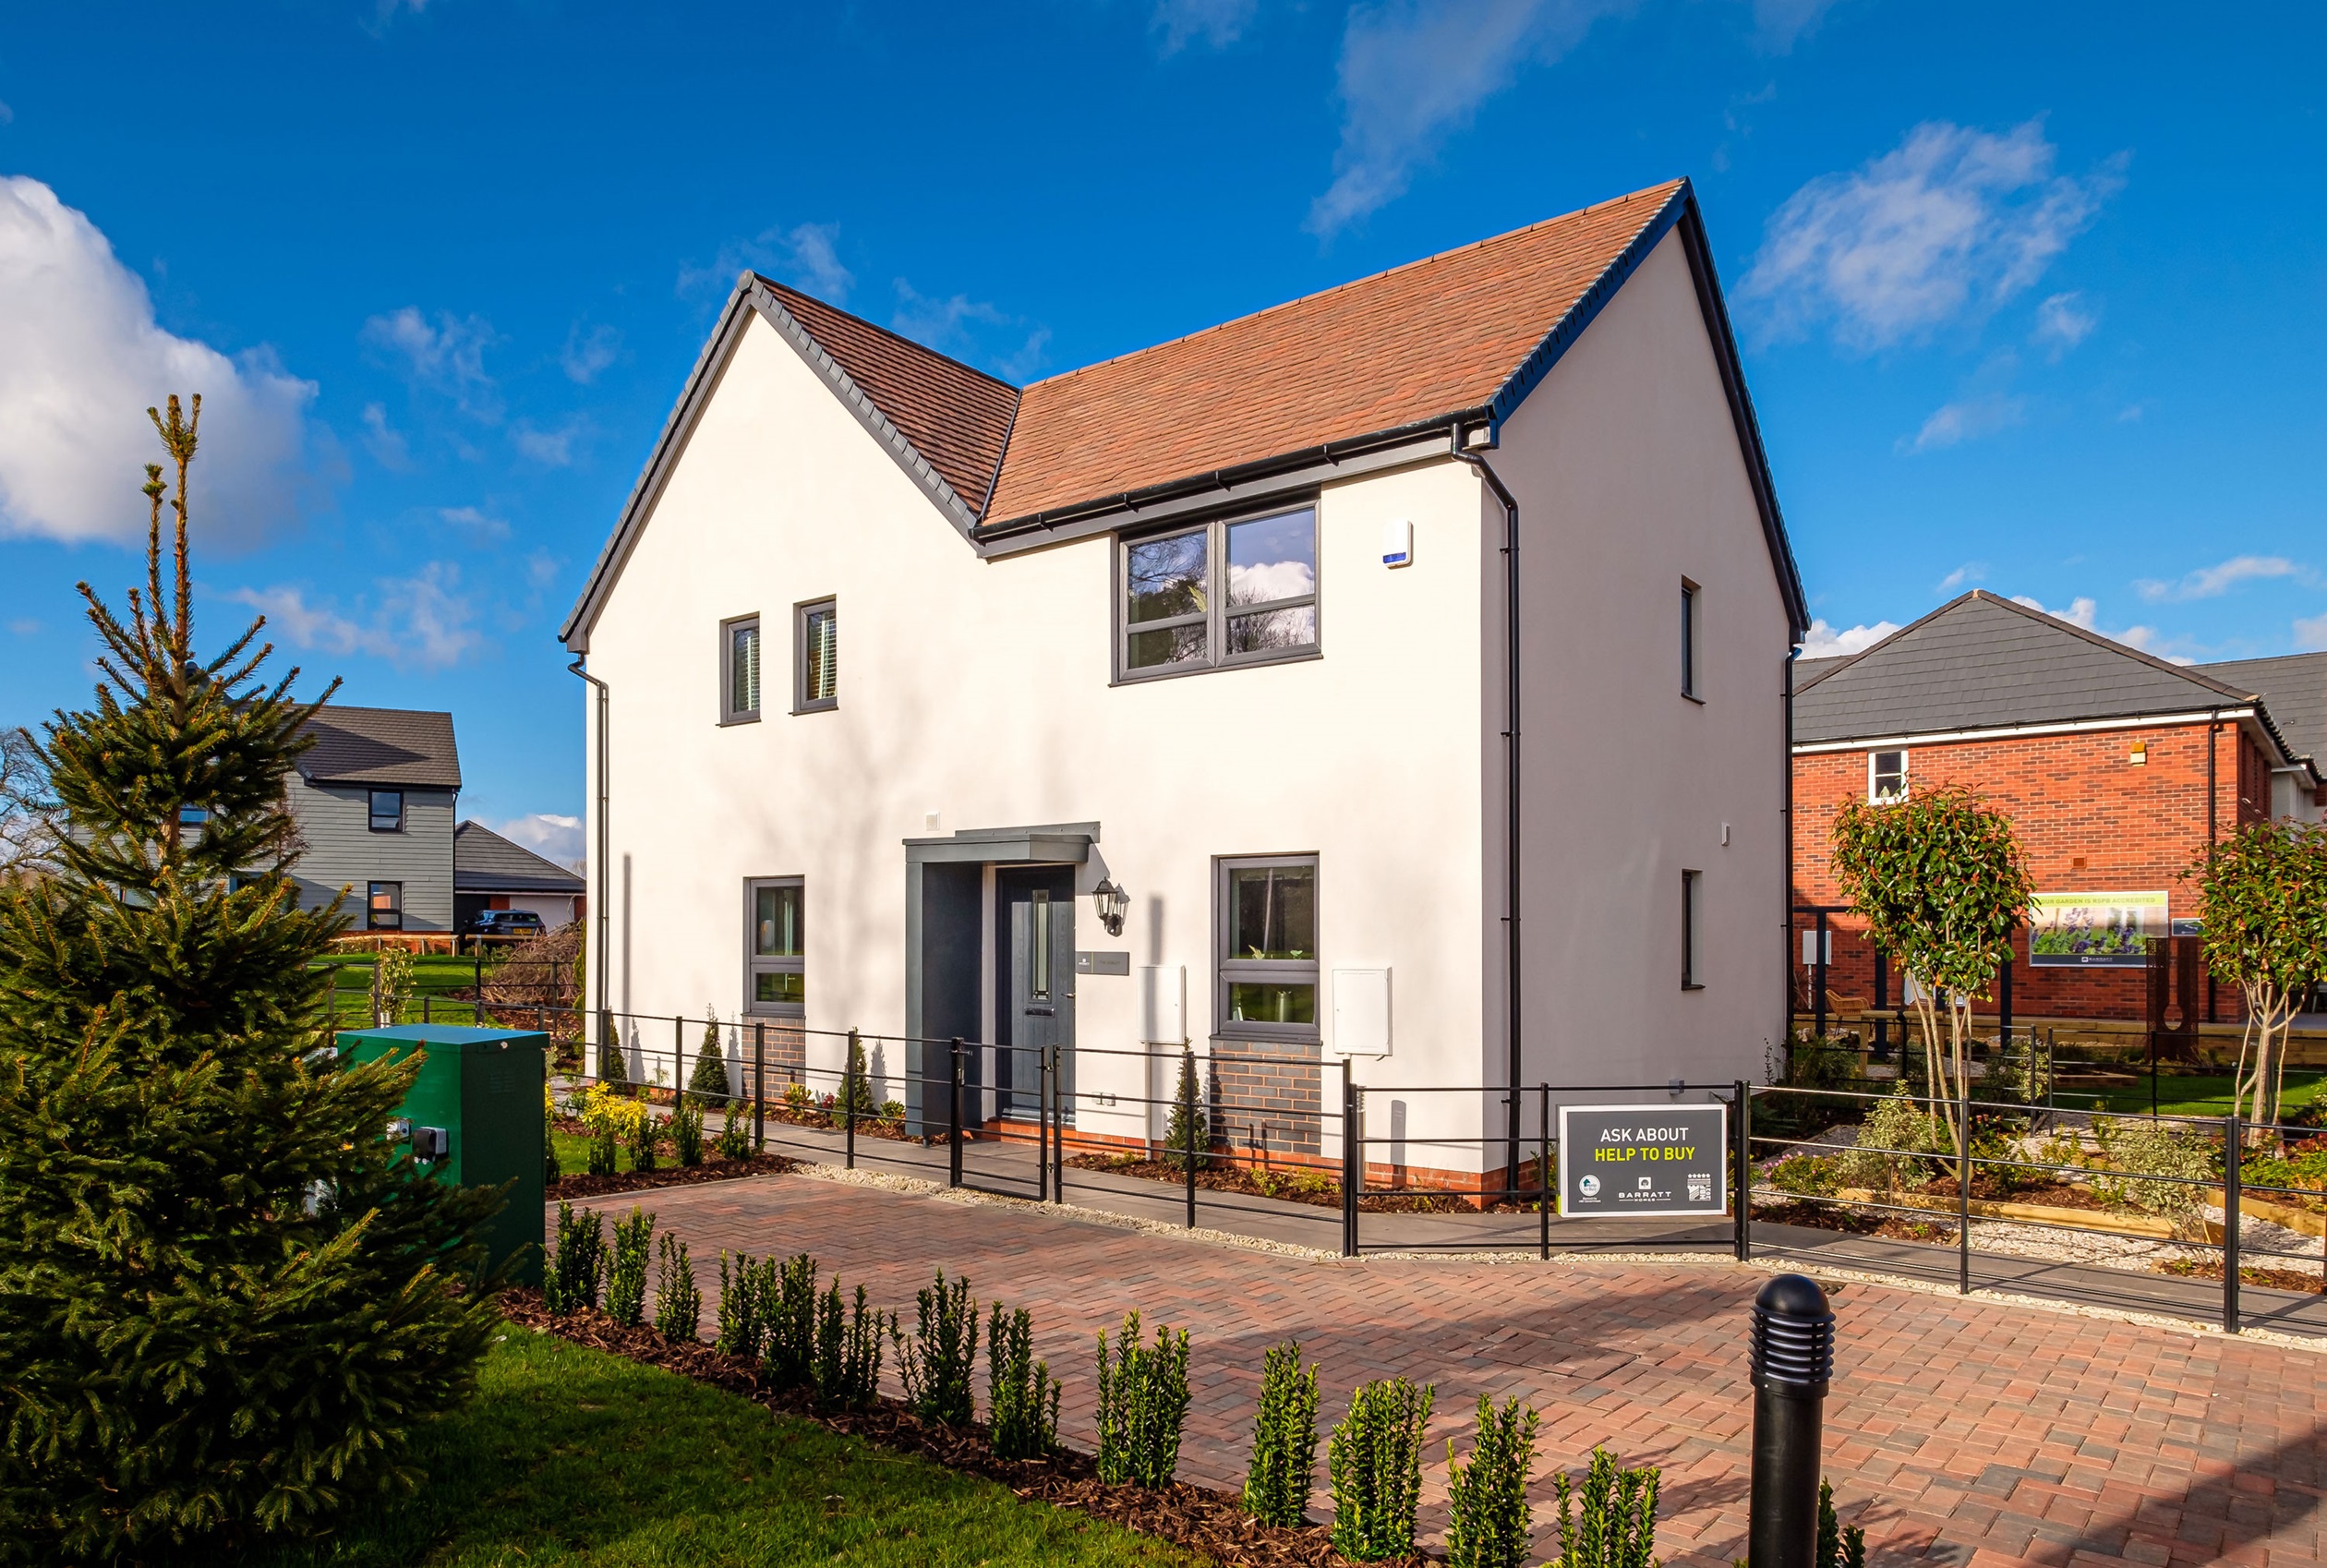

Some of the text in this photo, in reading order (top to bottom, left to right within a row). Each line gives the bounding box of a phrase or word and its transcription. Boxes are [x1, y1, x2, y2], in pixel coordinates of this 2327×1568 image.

[1600, 1128, 1689, 1142] ASK ABOUT
[1595, 1147, 1695, 1162] HELP TO BUY
